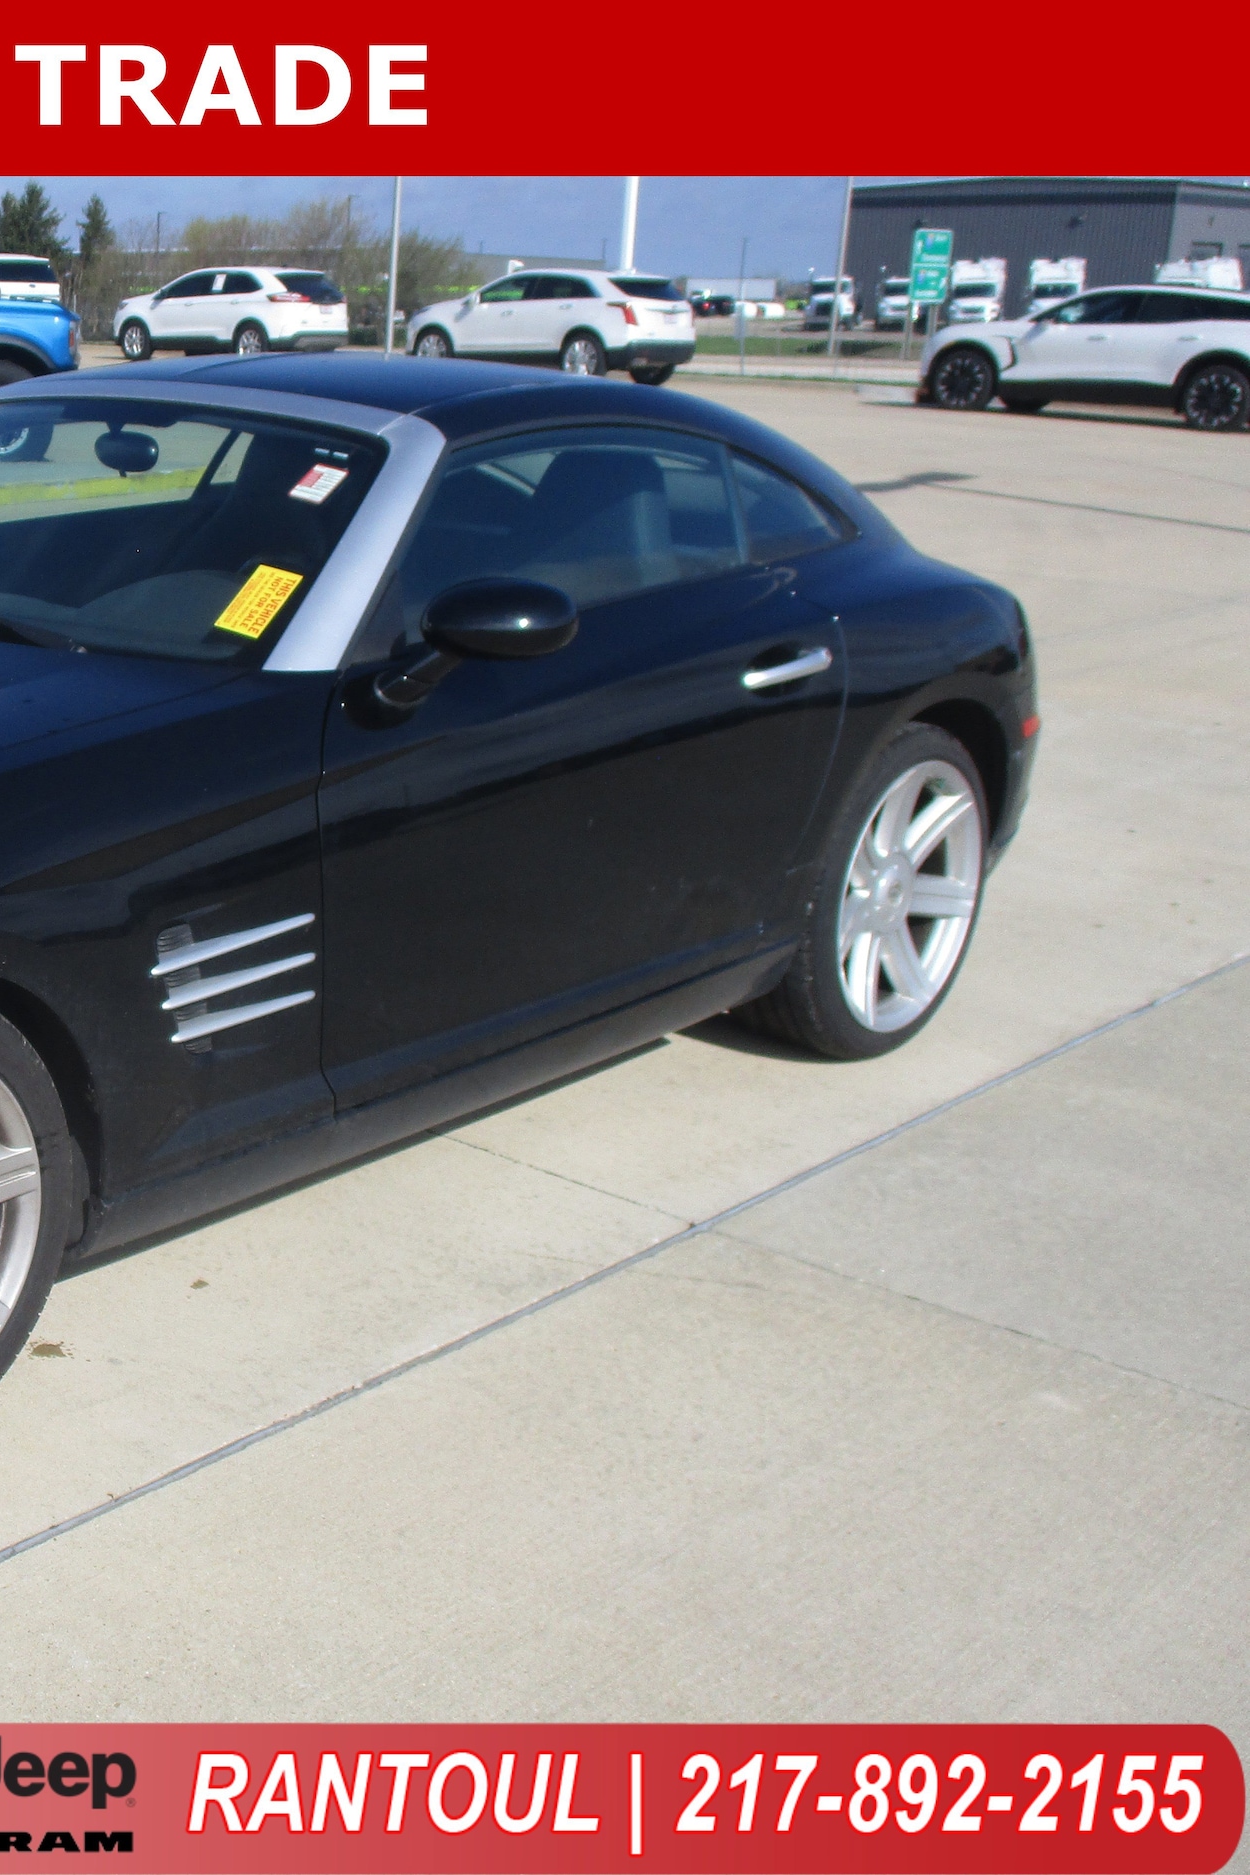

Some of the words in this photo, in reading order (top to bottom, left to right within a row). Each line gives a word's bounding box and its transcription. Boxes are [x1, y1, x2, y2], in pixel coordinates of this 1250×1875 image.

[271, 576, 284, 592] NOT
[275, 578, 297, 597] THIS
[255, 592, 271, 608] FOR
[239, 608, 258, 628] SALE
[248, 598, 281, 634] VEHICLE
